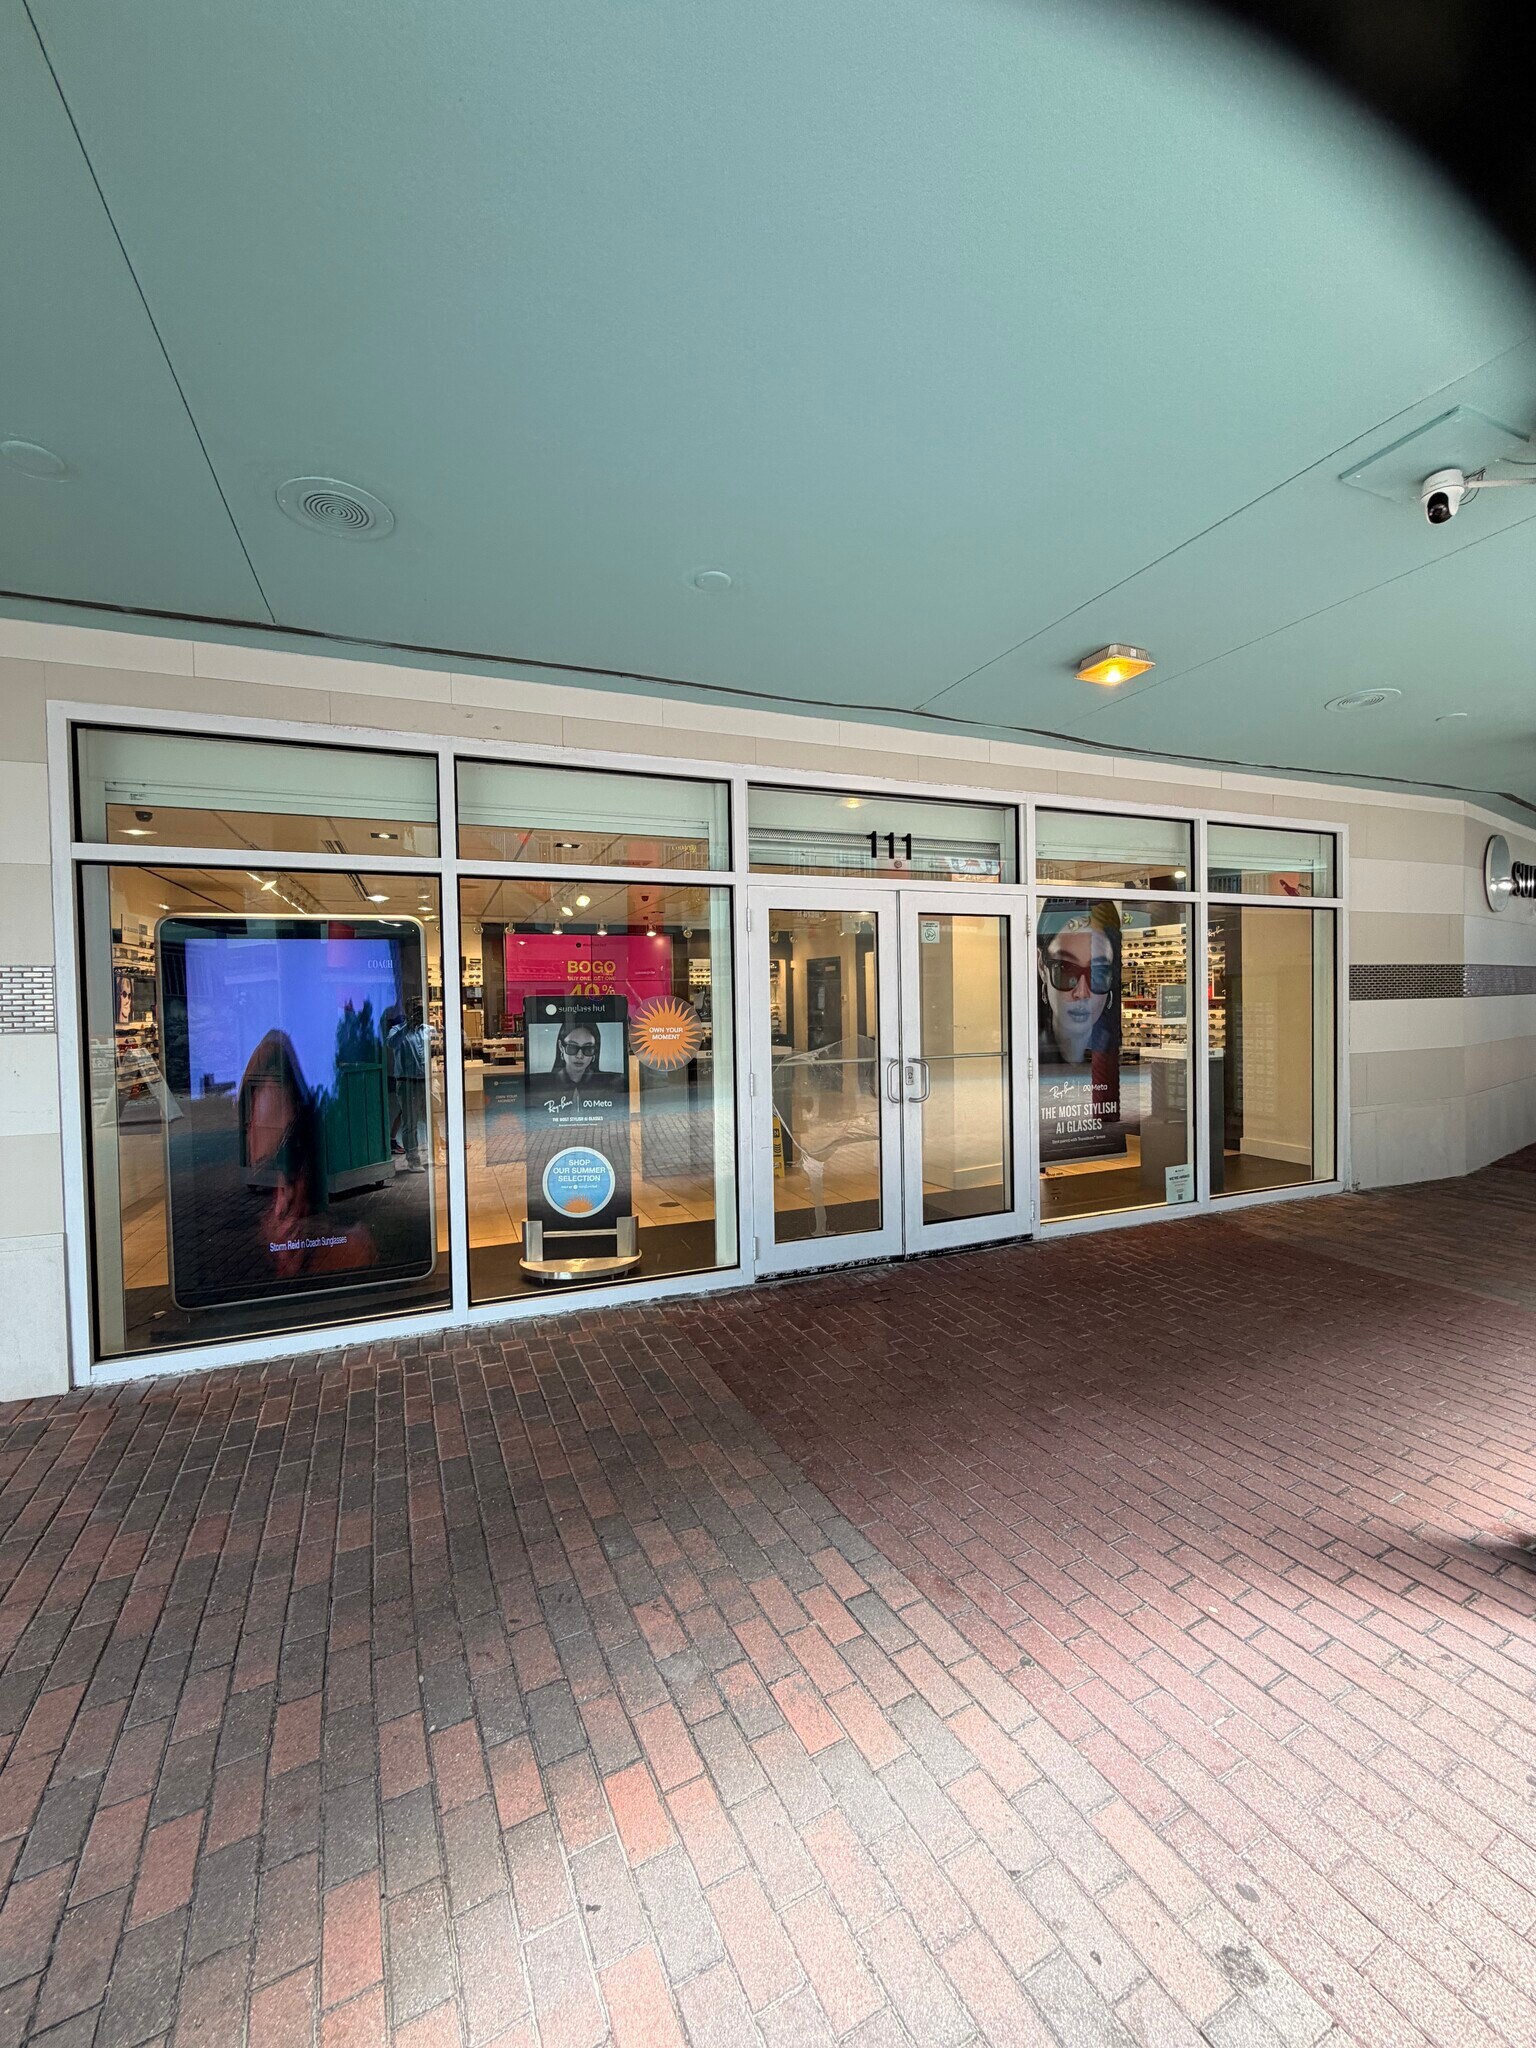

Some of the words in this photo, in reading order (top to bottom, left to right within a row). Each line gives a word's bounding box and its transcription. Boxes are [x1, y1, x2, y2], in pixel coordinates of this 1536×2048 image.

[866, 831, 912, 860] 111
[367, 959, 393, 969] COACH
[567, 960, 616, 974] BOGO
[558, 1004, 591, 1014] sunglass
[592, 1004, 605, 1012] hut
[1049, 1081, 1075, 1099] Ray-Ban
[544, 1096, 573, 1113] Ray-Ban
[593, 1100, 613, 1108] Meta
[1041, 1107, 1057, 1120] THE
[1059, 1105, 1082, 1118] MOST
[1084, 1102, 1117, 1116] STYLISH
[1056, 1121, 1065, 1134] AI
[1067, 1118, 1102, 1133] GLASSES
[269, 1242, 287, 1252] Storm
[287, 1240, 300, 1250] Reid
[306, 1238, 320, 1247] Coach
[322, 1236, 347, 1247] Sunglasses
